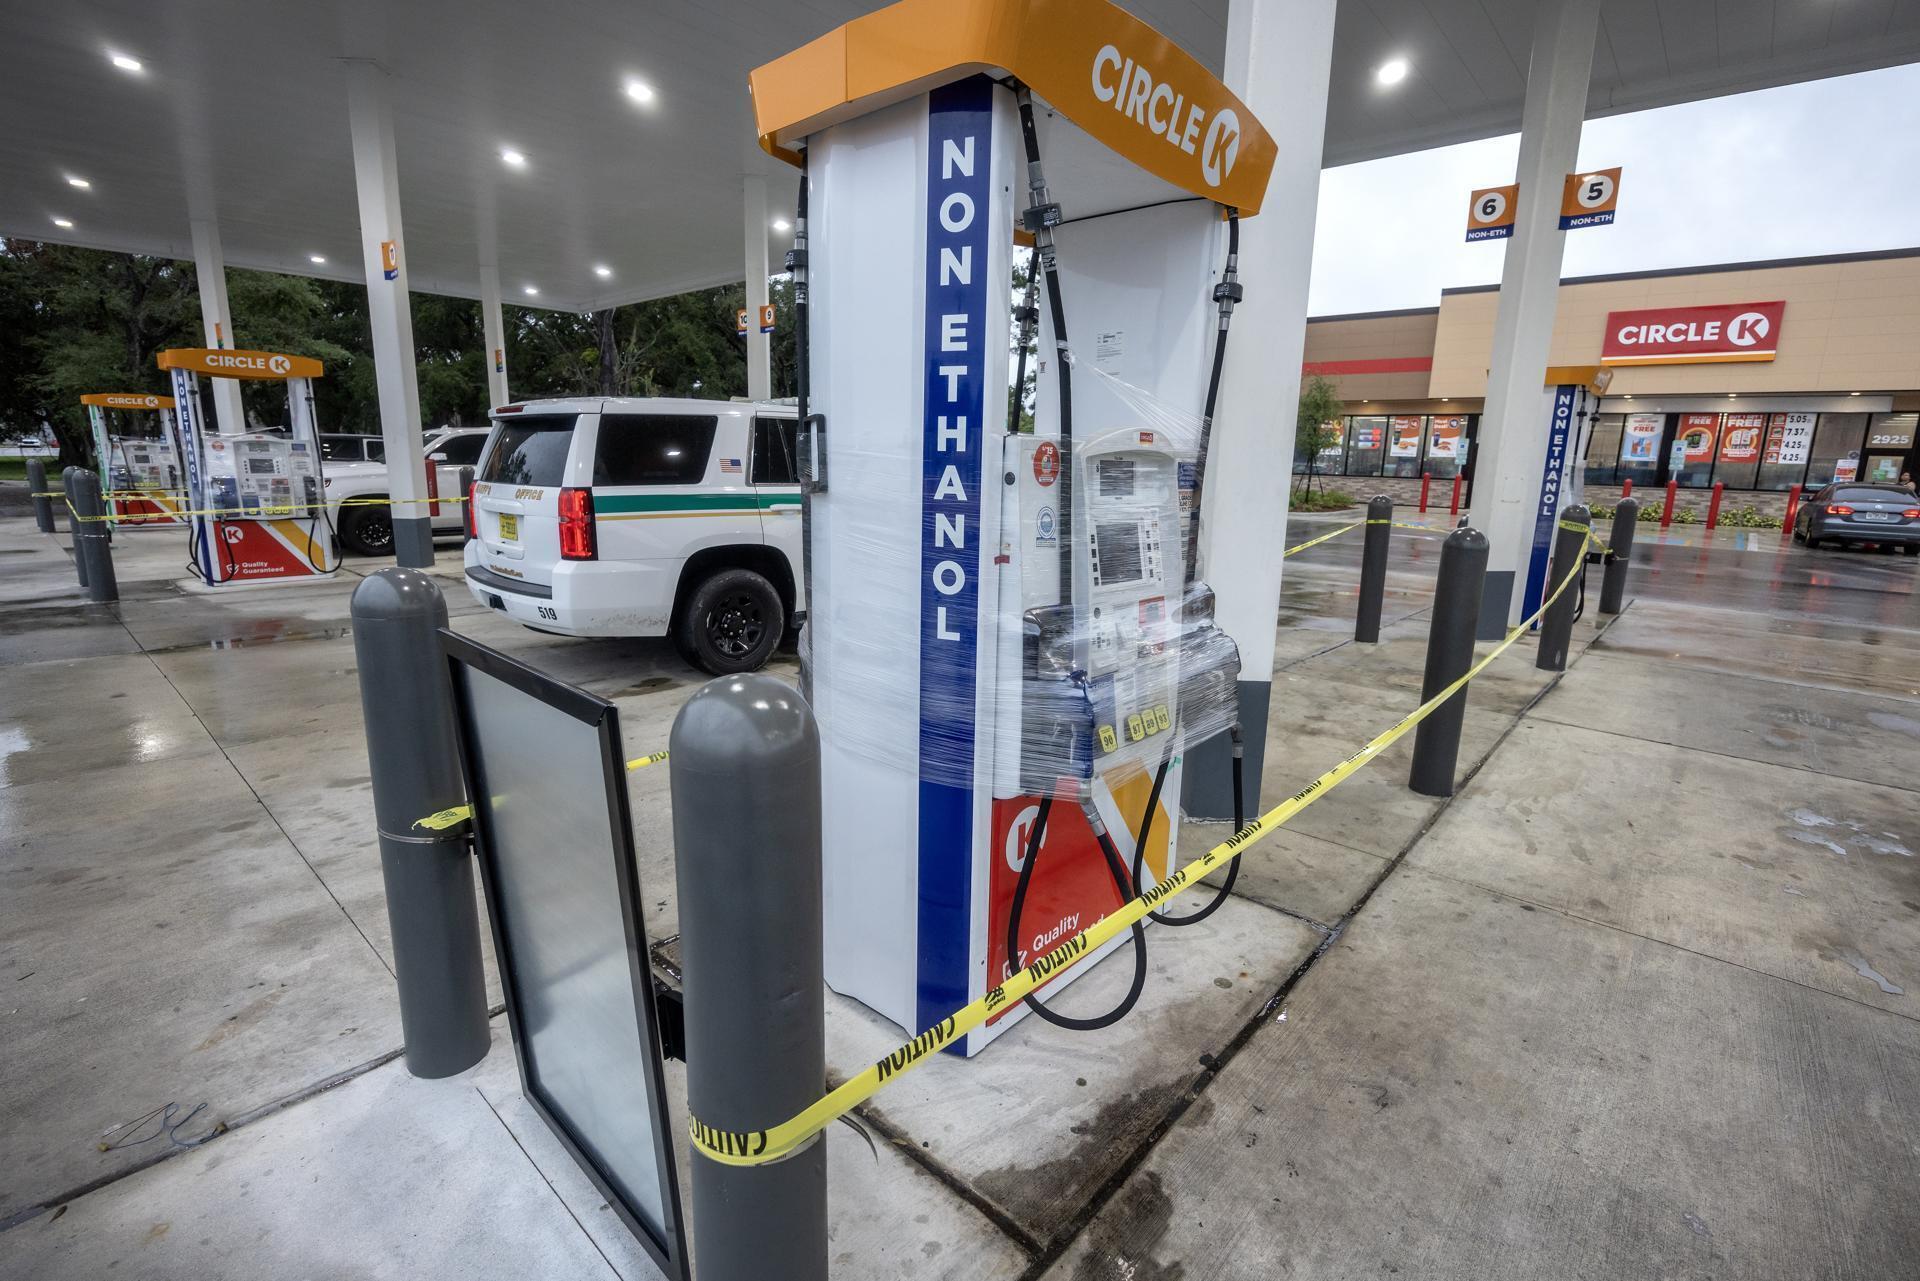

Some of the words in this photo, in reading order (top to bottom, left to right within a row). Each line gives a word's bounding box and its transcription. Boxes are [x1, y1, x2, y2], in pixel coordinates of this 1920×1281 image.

[1092, 44, 1205, 156] CIRCLE
[1205, 112, 1239, 186] K
[1482, 198, 1496, 216] 6
[1587, 182, 1603, 201] 5
[939, 136, 975, 287] NON
[1570, 213, 1613, 226] NON-ETH
[1468, 228, 1506, 240] NON-ETH
[1617, 321, 1722, 346] CIRCLE
[1732, 314, 1767, 345] K
[205, 354, 266, 370] CIRCLE
[271, 356, 290, 374] K
[107, 396, 144, 405] CIRCLE
[1555, 394, 1571, 430] NON
[177, 374, 187, 410] NON
[182, 411, 198, 484] ETHANOL
[1633, 425, 1656, 433] FREE
[1728, 419, 1763, 428] FREE
[1871, 434, 1911, 445] 2925
[932, 313, 969, 641] ETHANOL
[1542, 434, 1564, 516] ETHANOL
[224, 527, 243, 543] K
[537, 605, 558, 621] 519
[1140, 870, 1187, 908] CAUTION
[1033, 912, 1080, 951] Quality
[1029, 932, 1088, 983] CAUTION
[876, 1015, 956, 1082] CAUTION
[688, 1113, 768, 1157] CAUTIO
